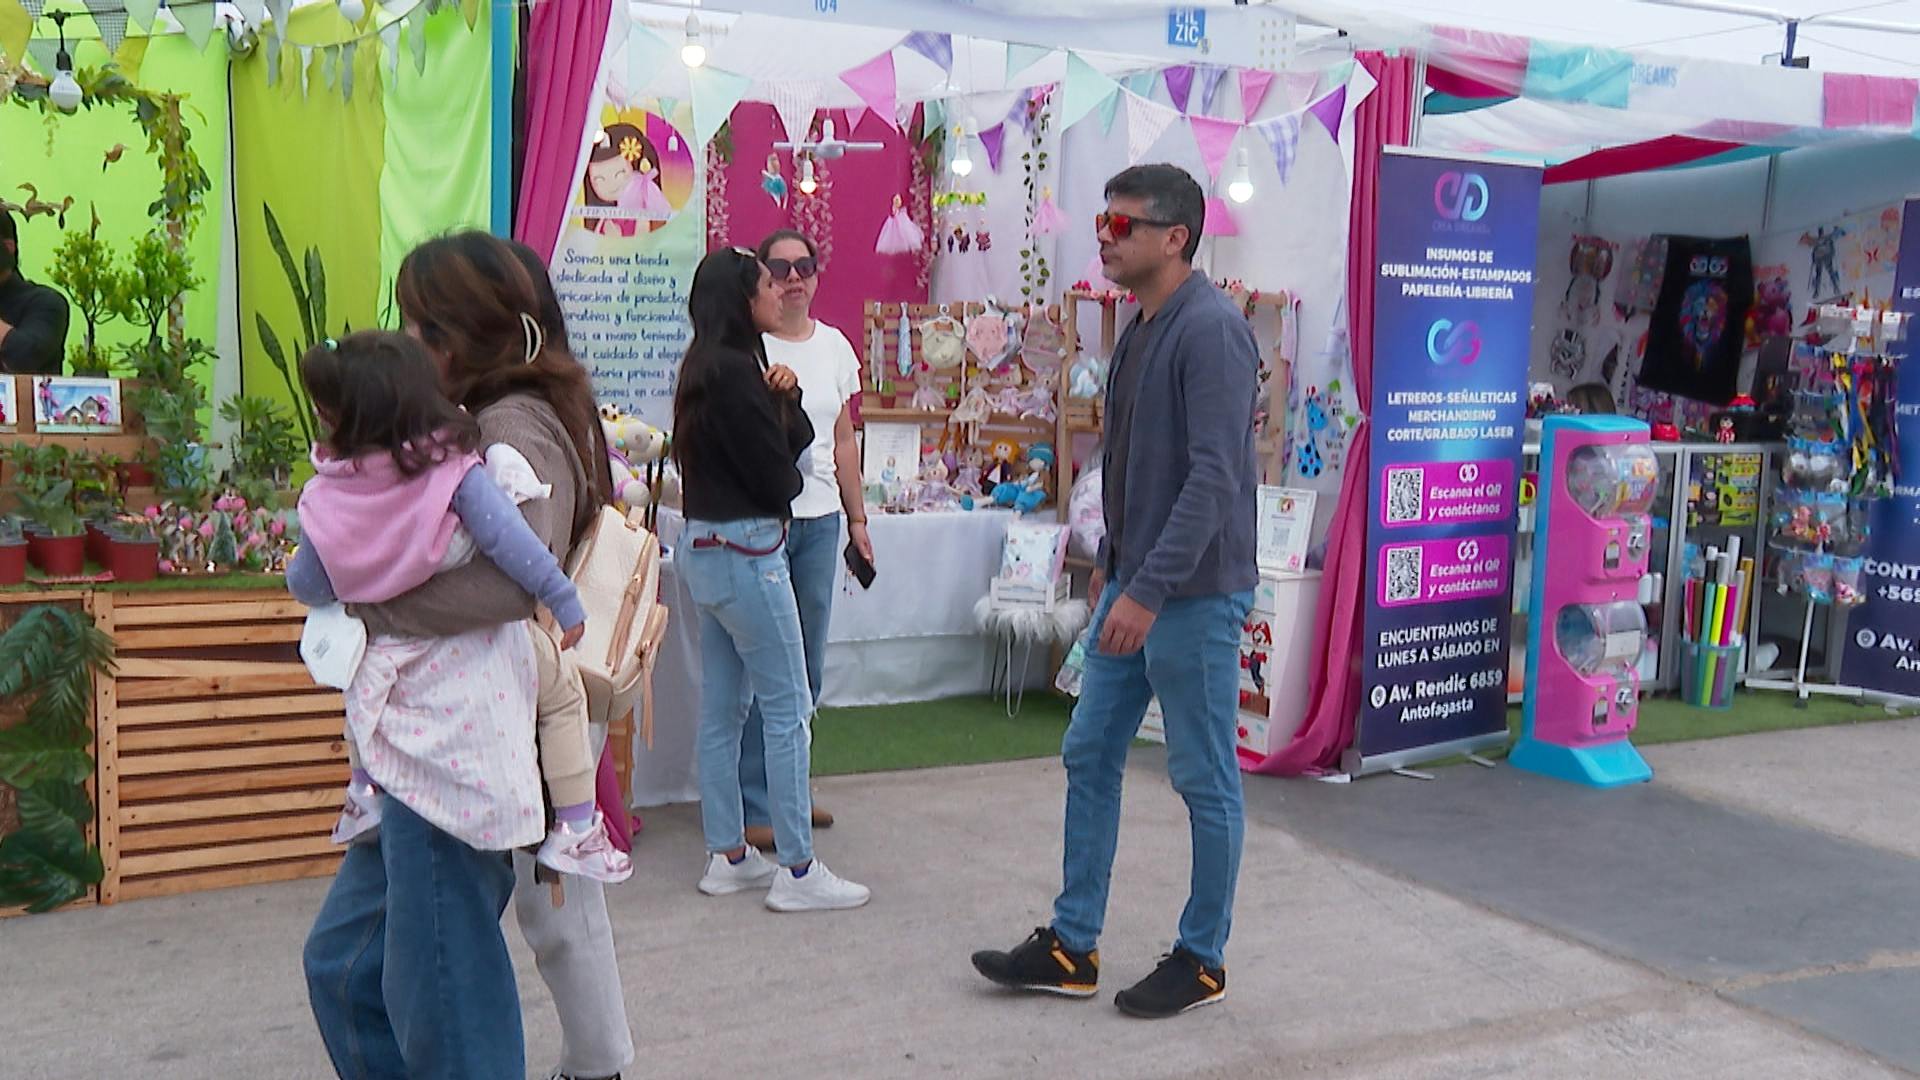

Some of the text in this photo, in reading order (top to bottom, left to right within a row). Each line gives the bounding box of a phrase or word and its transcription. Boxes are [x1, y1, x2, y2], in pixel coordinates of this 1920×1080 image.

[1175, 23, 1199, 43] ZIC
[564, 248, 670, 266] Somos una tienda
[1426, 247, 1494, 263] INSUMOS DE
[556, 268, 613, 284] dedicada
[617, 270, 629, 284] al
[668, 276, 677, 289] y
[616, 288, 631, 303] de
[614, 313, 622, 328] y
[606, 331, 638, 342] mano
[641, 327, 687, 342] teniendo
[593, 346, 639, 360] cuidado
[643, 346, 654, 360] al
[1407, 408, 1497, 423] MERCHANDISING
[1387, 424, 1515, 442] CORTE/GRABADO LASER
[1430, 482, 1503, 500] Escanea el QR
[1428, 502, 1501, 522] y contáctanos
[1430, 563, 1472, 578] Escanea
[1473, 559, 1484, 574] el
[1428, 583, 1438, 599] y
[1380, 617, 1498, 648] ENCUENTRANOS DE
[1880, 632, 1914, 652] Av.
[1377, 637, 1501, 669] LUNES A SÁBADO EN
[1389, 667, 1503, 704] Av. Rendic 6859
[1400, 697, 1475, 723] Antofagasta
